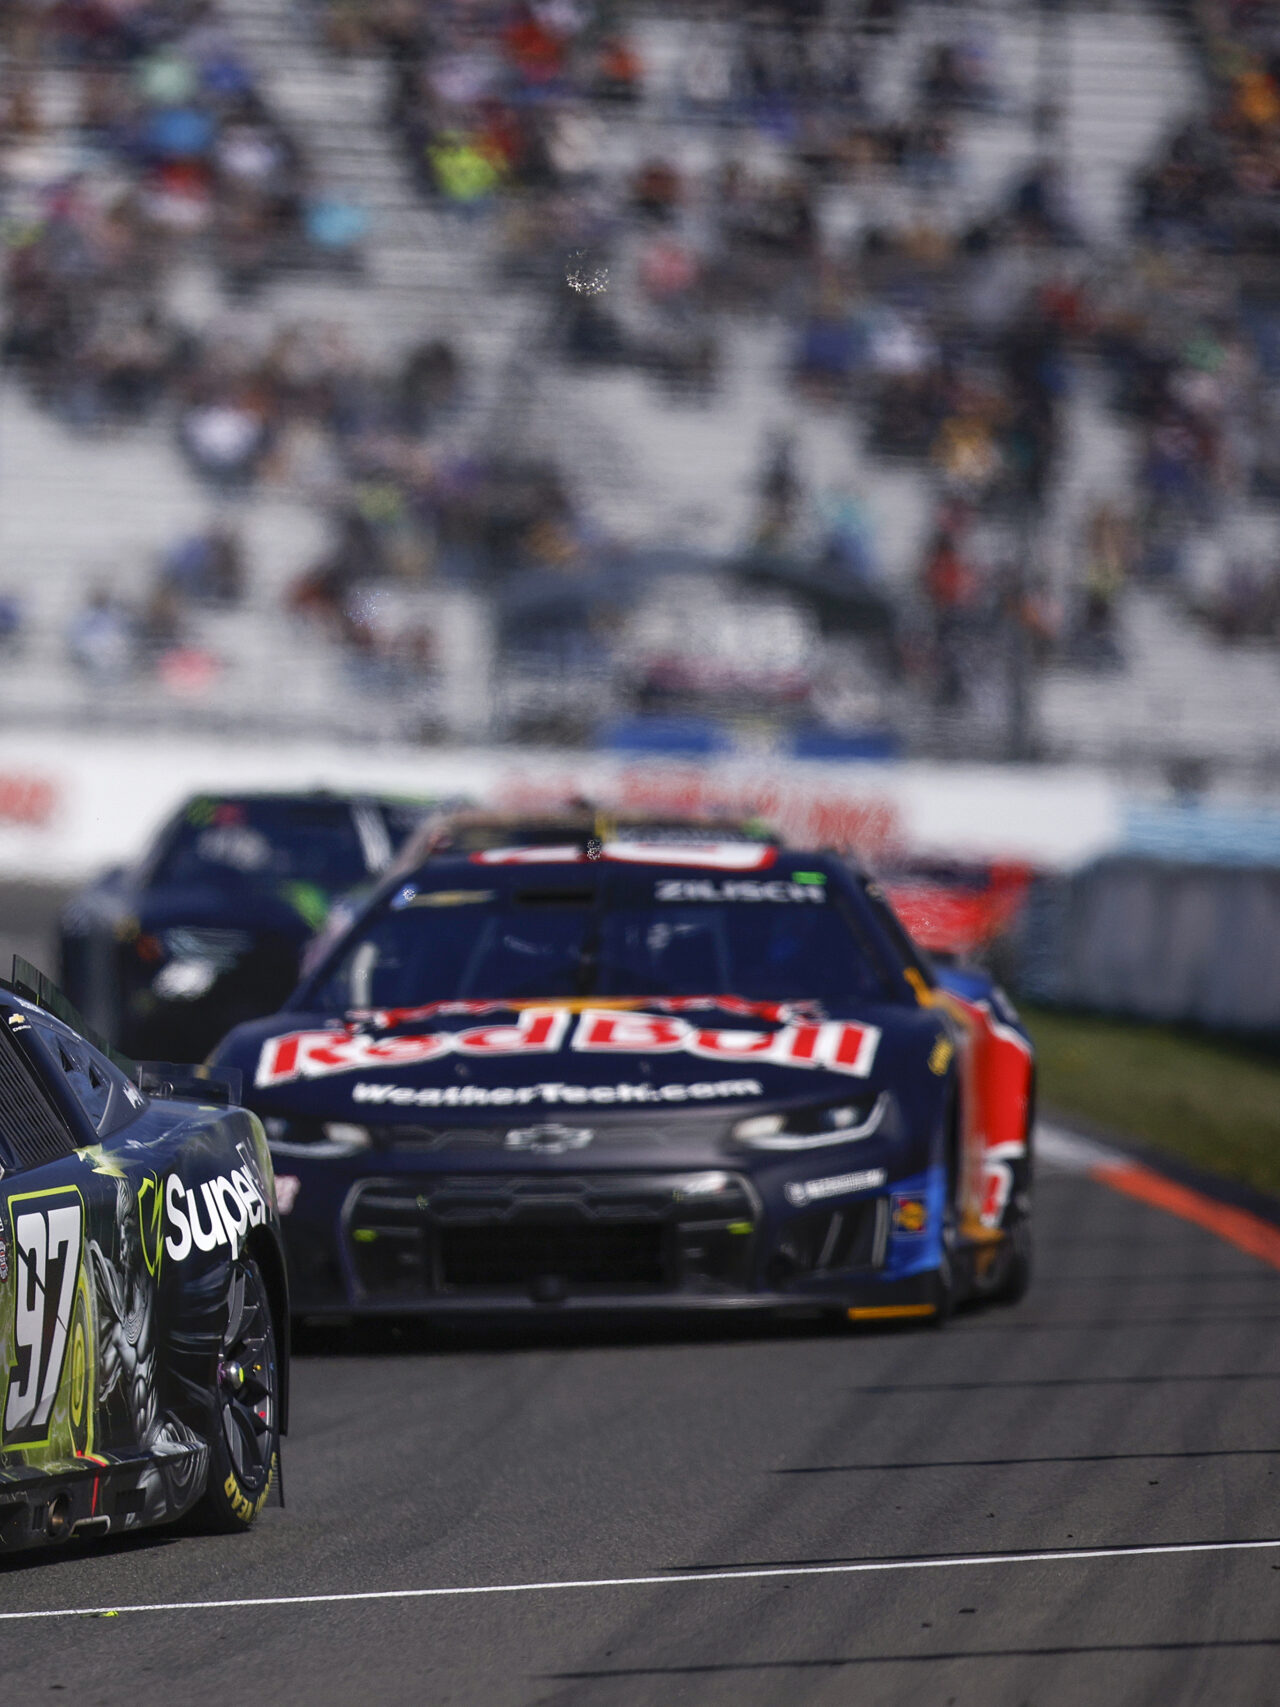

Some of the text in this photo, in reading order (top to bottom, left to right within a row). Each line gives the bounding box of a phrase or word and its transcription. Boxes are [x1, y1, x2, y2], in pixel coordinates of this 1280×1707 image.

[655, 879, 827, 904] ZILISCH
[255, 1007, 571, 1089] Red
[571, 1008, 882, 1079] Bull
[352, 1080, 764, 1106] WeatherTech.com
[5, 1205, 82, 1432] 97
